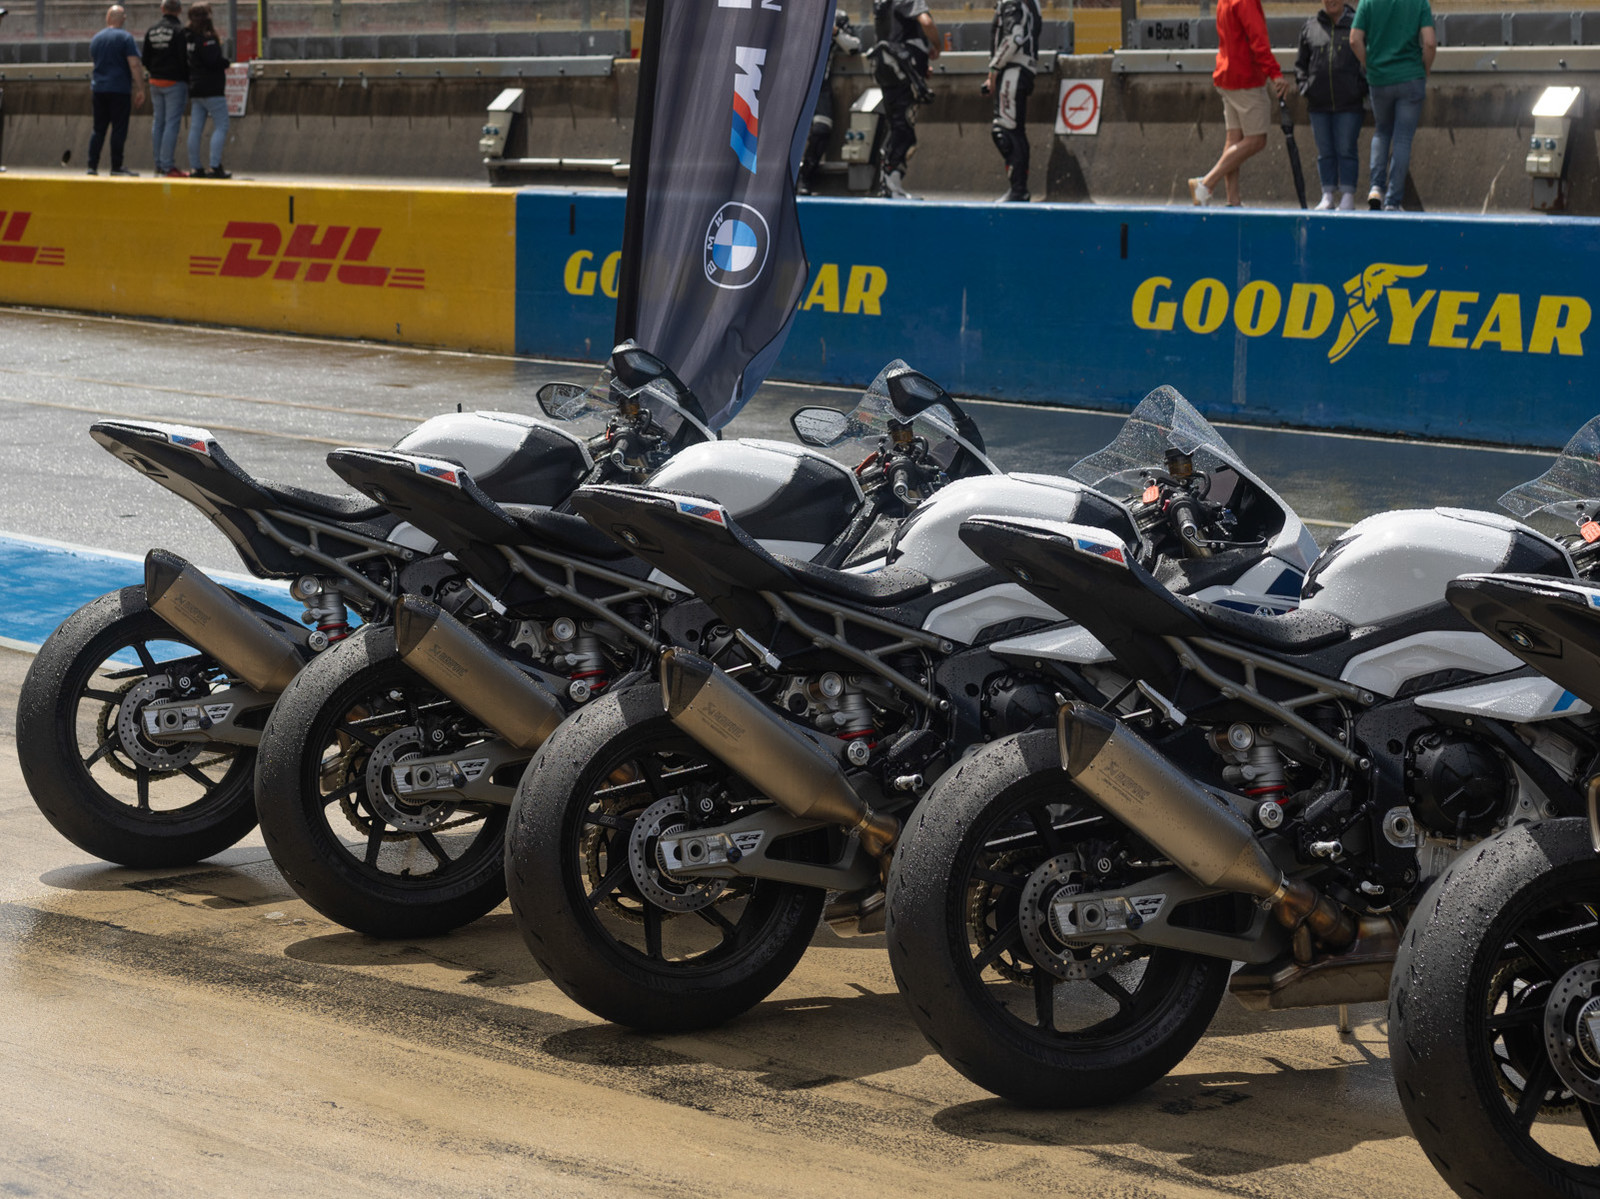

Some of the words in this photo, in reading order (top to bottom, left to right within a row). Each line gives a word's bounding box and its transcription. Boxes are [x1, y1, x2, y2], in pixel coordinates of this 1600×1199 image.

[1155, 22, 1174, 40] Box
[1176, 22, 1190, 41] 48
[219, 221, 391, 287] DHL
[706, 212, 725, 276] BMW
